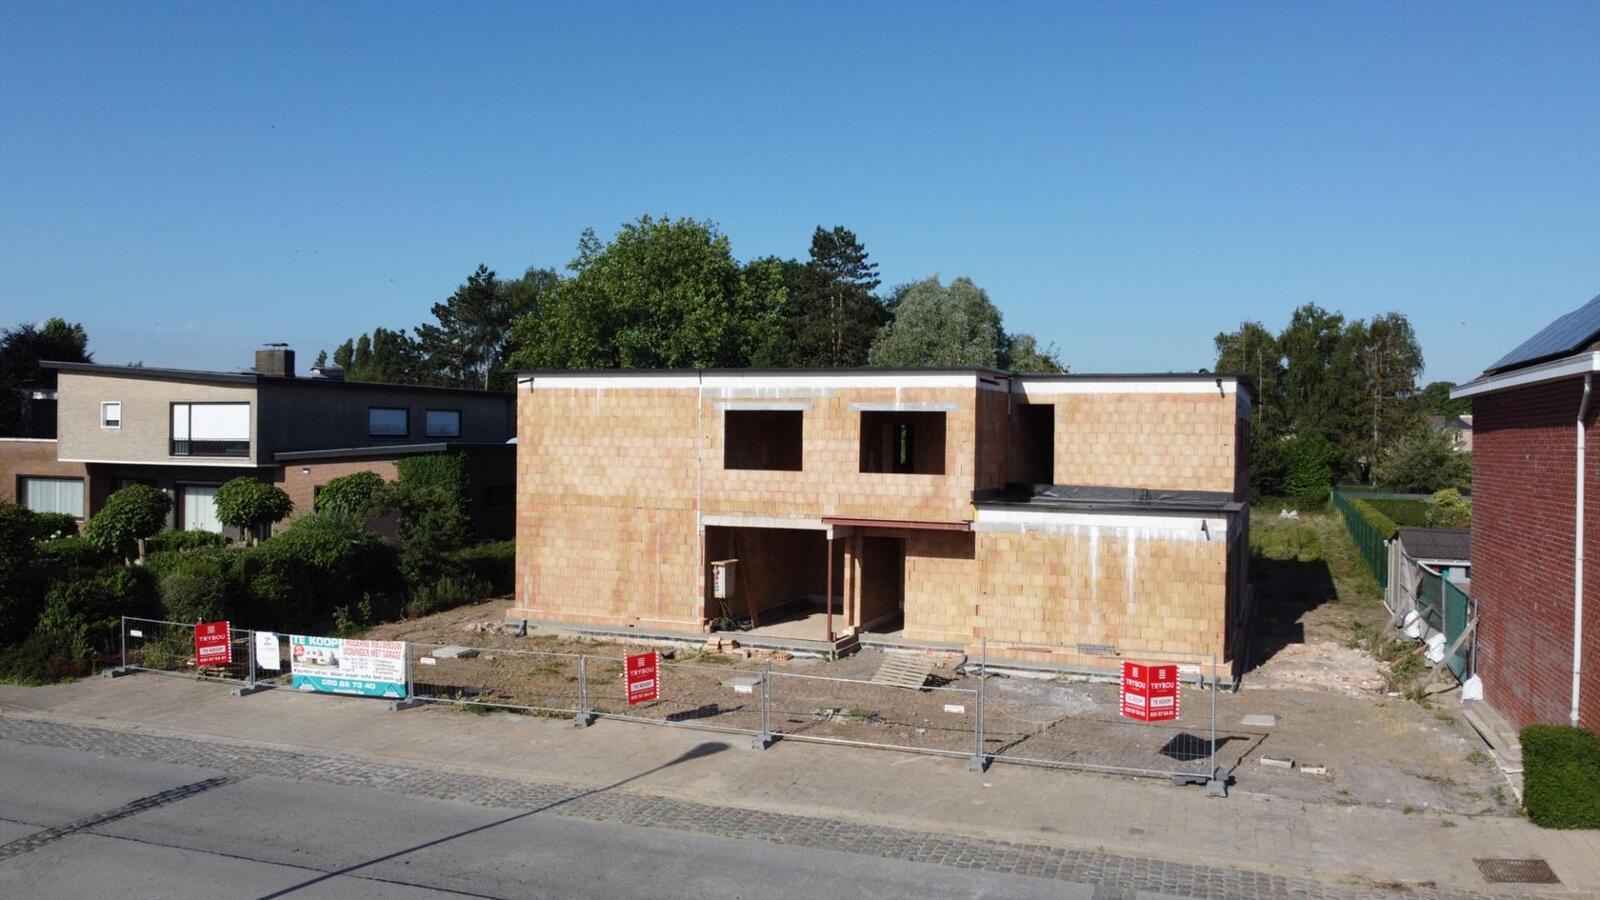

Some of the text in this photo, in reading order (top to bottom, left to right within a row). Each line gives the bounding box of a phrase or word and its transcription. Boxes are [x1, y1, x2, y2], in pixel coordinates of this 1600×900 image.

[293, 635, 338, 647] TE KOOP
[630, 667, 654, 676] TRYBOU
[1126, 678, 1146, 689] TRYBOU
[1151, 682, 1175, 690] TRYBOU
